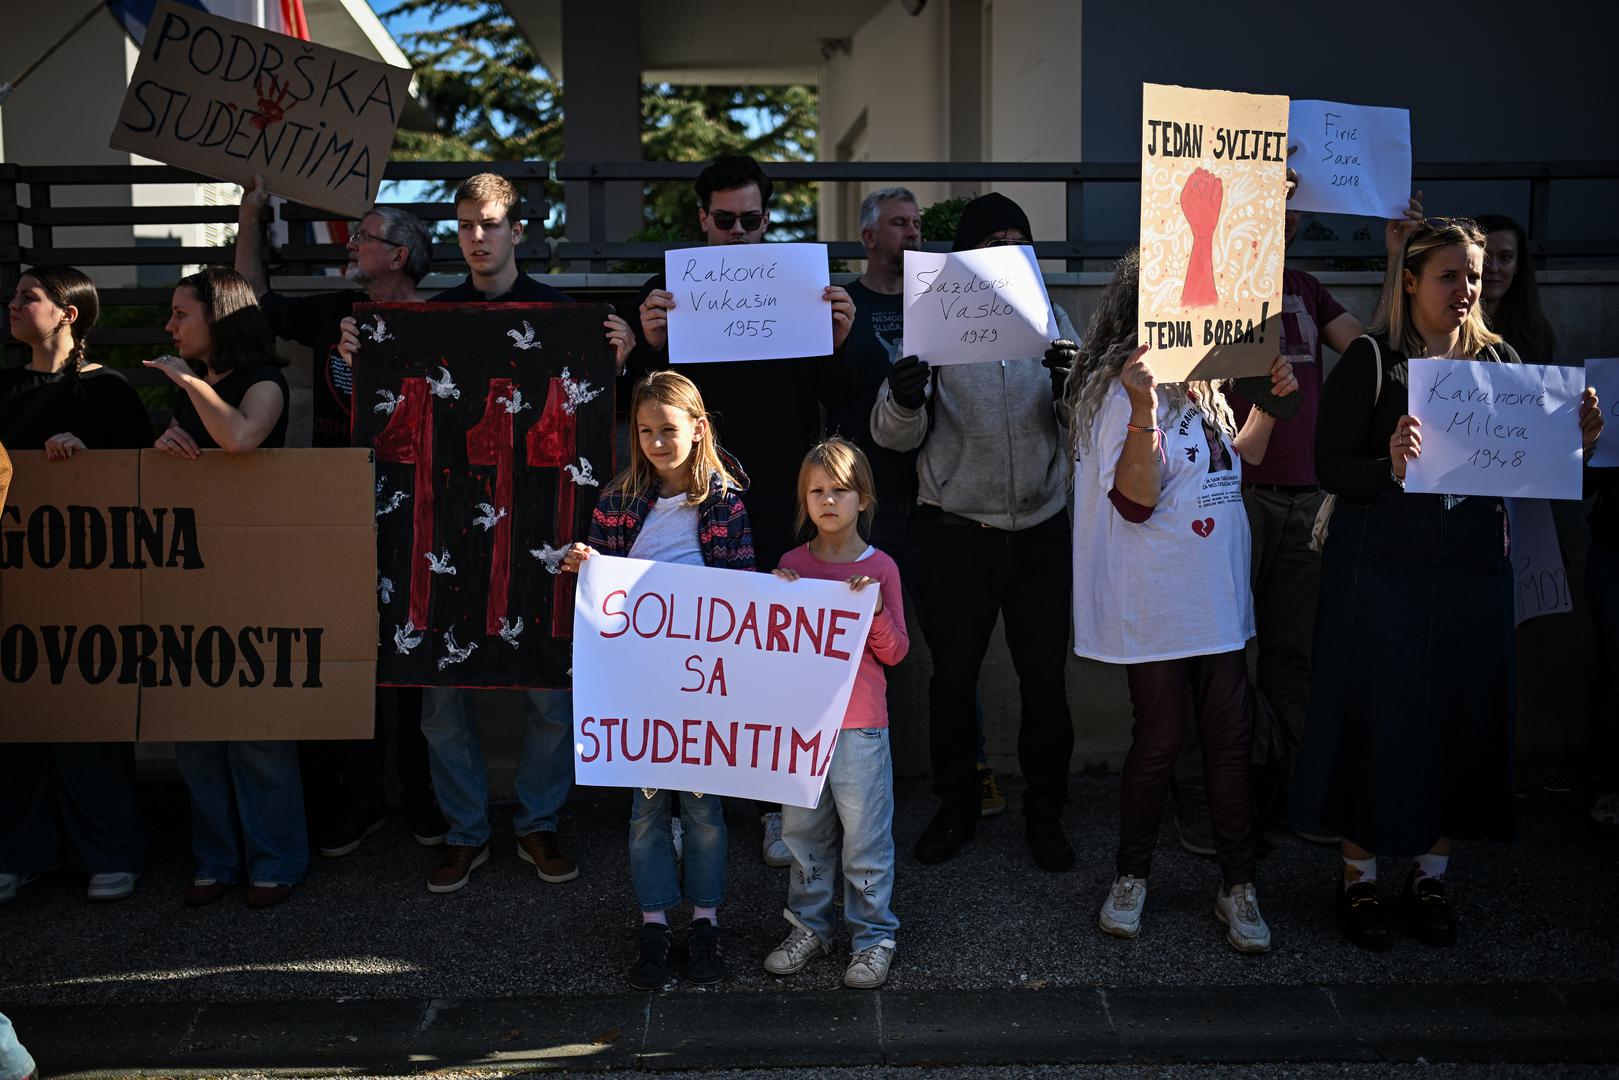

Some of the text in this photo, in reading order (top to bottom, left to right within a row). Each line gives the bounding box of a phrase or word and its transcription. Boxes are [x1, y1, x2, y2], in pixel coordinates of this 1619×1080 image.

[152, 12, 395, 125] PODRŠKA
[1147, 119, 1203, 158] JEDAN
[1321, 141, 1361, 166] Sara
[1330, 174, 1360, 187] 2018
[682, 258, 778, 282] Raković
[690, 289, 777, 312] Vukašin
[940, 292, 1014, 320] Vasko
[723, 319, 777, 338] 1955
[960, 328, 998, 343] 1979
[1144, 320, 1193, 351] JEDNA
[1467, 449, 1526, 469] 1948
[600, 588, 861, 661] SOLIDARNE
[0, 624, 324, 688] OVORNOSTI
[681, 654, 727, 696] SA
